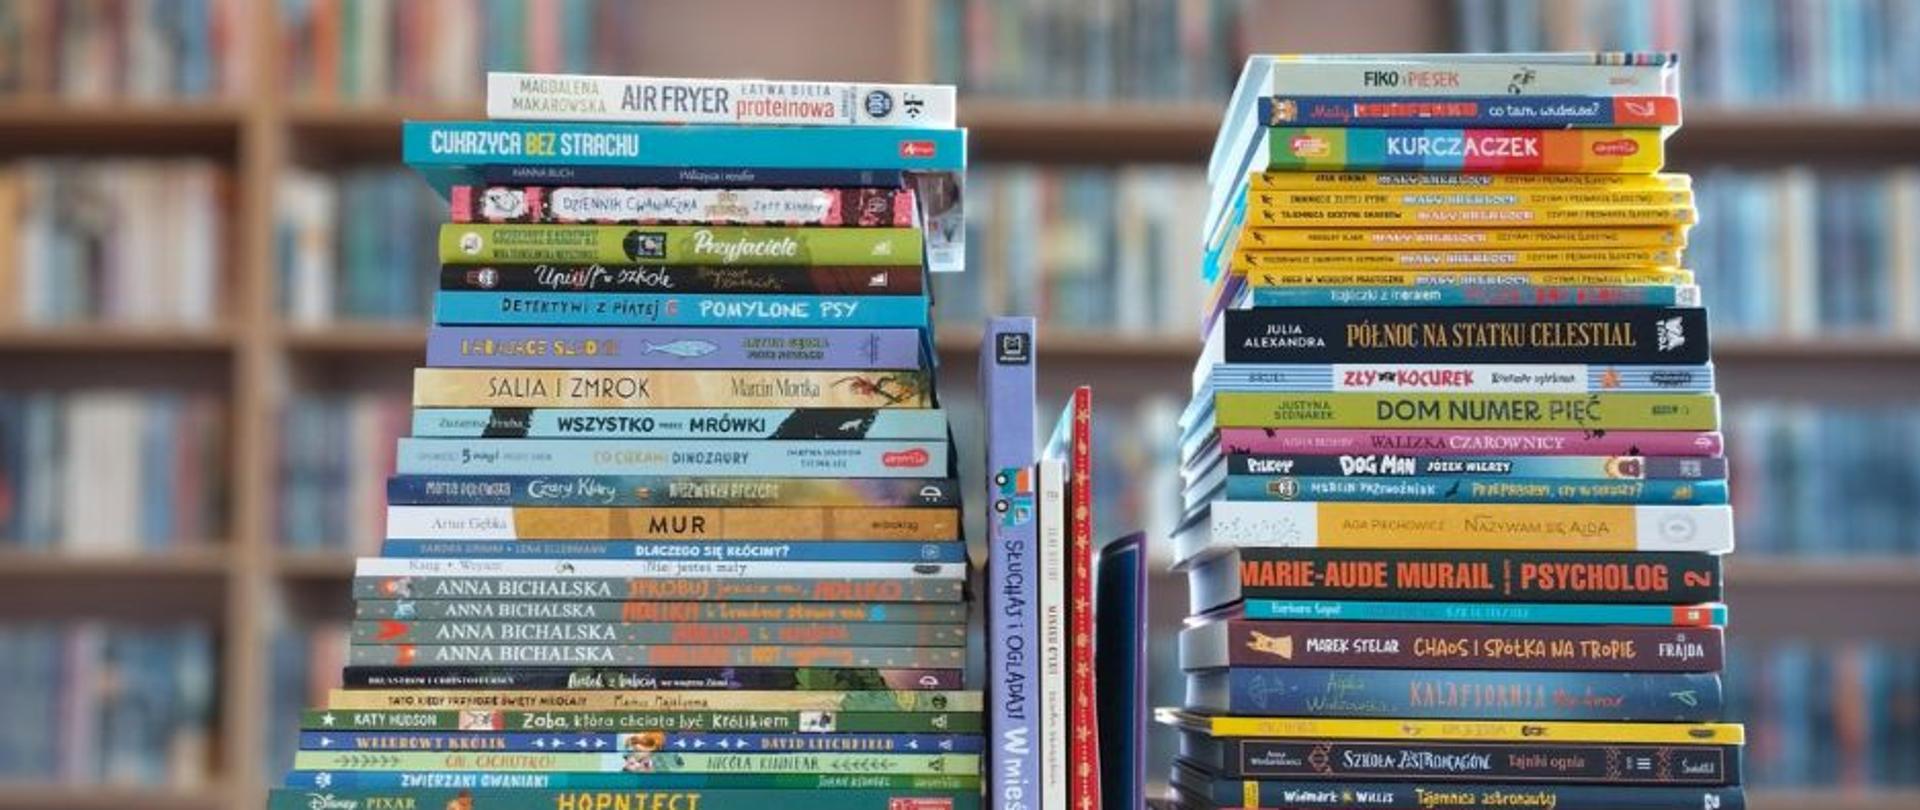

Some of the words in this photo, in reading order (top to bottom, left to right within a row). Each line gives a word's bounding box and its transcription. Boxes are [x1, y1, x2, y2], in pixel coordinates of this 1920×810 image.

[520, 79, 599, 94] MAGDALENA
[1364, 71, 1398, 87] FIKO
[1408, 71, 1459, 87] PIESEK
[511, 97, 607, 113] MAKAROWSKA
[621, 84, 658, 112] AIR
[661, 85, 729, 114] FRYER
[736, 97, 835, 119] proteinowa
[431, 131, 521, 154] CUKRZYCA
[525, 132, 556, 156] BEZ
[560, 133, 640, 157] STRACHU
[1387, 136, 1538, 158] KURCZACZEK
[563, 197, 622, 212] DZIENNIK
[693, 229, 798, 264] Przyjaciele
[618, 265, 675, 289] szkole
[501, 297, 588, 314] DETEKTYWI
[699, 299, 810, 318] POMYLONE
[820, 301, 858, 318] PSY
[1266, 324, 1302, 335] JULIA
[1346, 319, 1419, 347] PÓŁNOC
[1423, 324, 1448, 347] NA
[1452, 322, 1526, 348] STATKU
[1530, 322, 1636, 347] CELESTIAL
[1243, 337, 1326, 348] ALEXANDRA
[1343, 370, 1377, 386] ZŁY
[1398, 369, 1474, 387] KOCUREK
[488, 377, 547, 398] SALIA
[556, 378, 561, 397] I
[571, 377, 650, 399] ZMROK
[731, 377, 773, 397] Marcin
[776, 377, 820, 398] Mortka
[1278, 401, 1331, 410] JUSTYNA
[1377, 401, 1440, 420] DOM
[1449, 401, 1542, 421] NUMER
[1550, 394, 1603, 426] PIĘĆ
[557, 416, 655, 433] WSZYSTKO
[689, 412, 766, 433] MRÓWKI
[1274, 411, 1336, 420] BEDNAREK
[1370, 435, 1446, 449] WALIZKA
[1449, 436, 1565, 450] CZAROWNICY
[462, 449, 471, 463] 5
[672, 451, 749, 465] DINOZAURY
[1247, 457, 1294, 473] PILKEY
[1339, 455, 1378, 476] DOG
[1381, 455, 1416, 476] MAN
[431, 517, 464, 529] Artur
[468, 517, 508, 533] Gębka
[649, 516, 706, 534] MUR
[636, 544, 700, 557] DLACZEGO
[703, 545, 723, 560] SIĘ
[727, 544, 791, 559] KŁÓCIMY?
[1003, 539, 1025, 622] SŁUCHAJ
[1239, 560, 1389, 588] MARIE-AUDE
[1396, 561, 1494, 589] MURAIL
[1520, 563, 1669, 592] PSYCHOLOG
[1684, 570, 1712, 588] 2
[436, 580, 493, 596] ANNA
[499, 580, 612, 597] BICHALSKA
[445, 603, 494, 617] ANNA
[498, 603, 596, 618] BICHALSKA
[436, 622, 495, 640] ANNA
[500, 622, 617, 641] BICHALSKA
[436, 645, 495, 662] ANNA
[500, 645, 616, 662] BICHALSKA
[1306, 638, 1350, 654] MAREK
[1353, 638, 1400, 654] STELAR
[1483, 638, 1546, 656] SPÓŁKA
[1551, 640, 1575, 659] NA
[1580, 640, 1637, 660] TROPIE
[1658, 642, 1705, 661] FRAJDA
[1004, 634, 1027, 721] OGLĄDAJ!
[354, 713, 386, 727] KATY
[389, 714, 437, 728] HUDSON
[712, 712, 789, 729] Królikiem
[449, 735, 506, 749] KRÓLIK
[761, 738, 804, 749] DAVID
[807, 738, 894, 750] LITCHFIELD
[1003, 726, 1030, 757] W
[706, 756, 751, 770] NICOLA
[760, 756, 819, 770] KINNEAR
[1342, 749, 1395, 769] SZKOŁA
[400, 774, 475, 789] ZWIERZAKI
[480, 774, 549, 789] CWANIAKI
[305, 793, 358, 810] Disney
[366, 798, 417, 810] PIXAR
[1415, 787, 1476, 808] Tajemnica
[1481, 790, 1557, 808] astronauty
